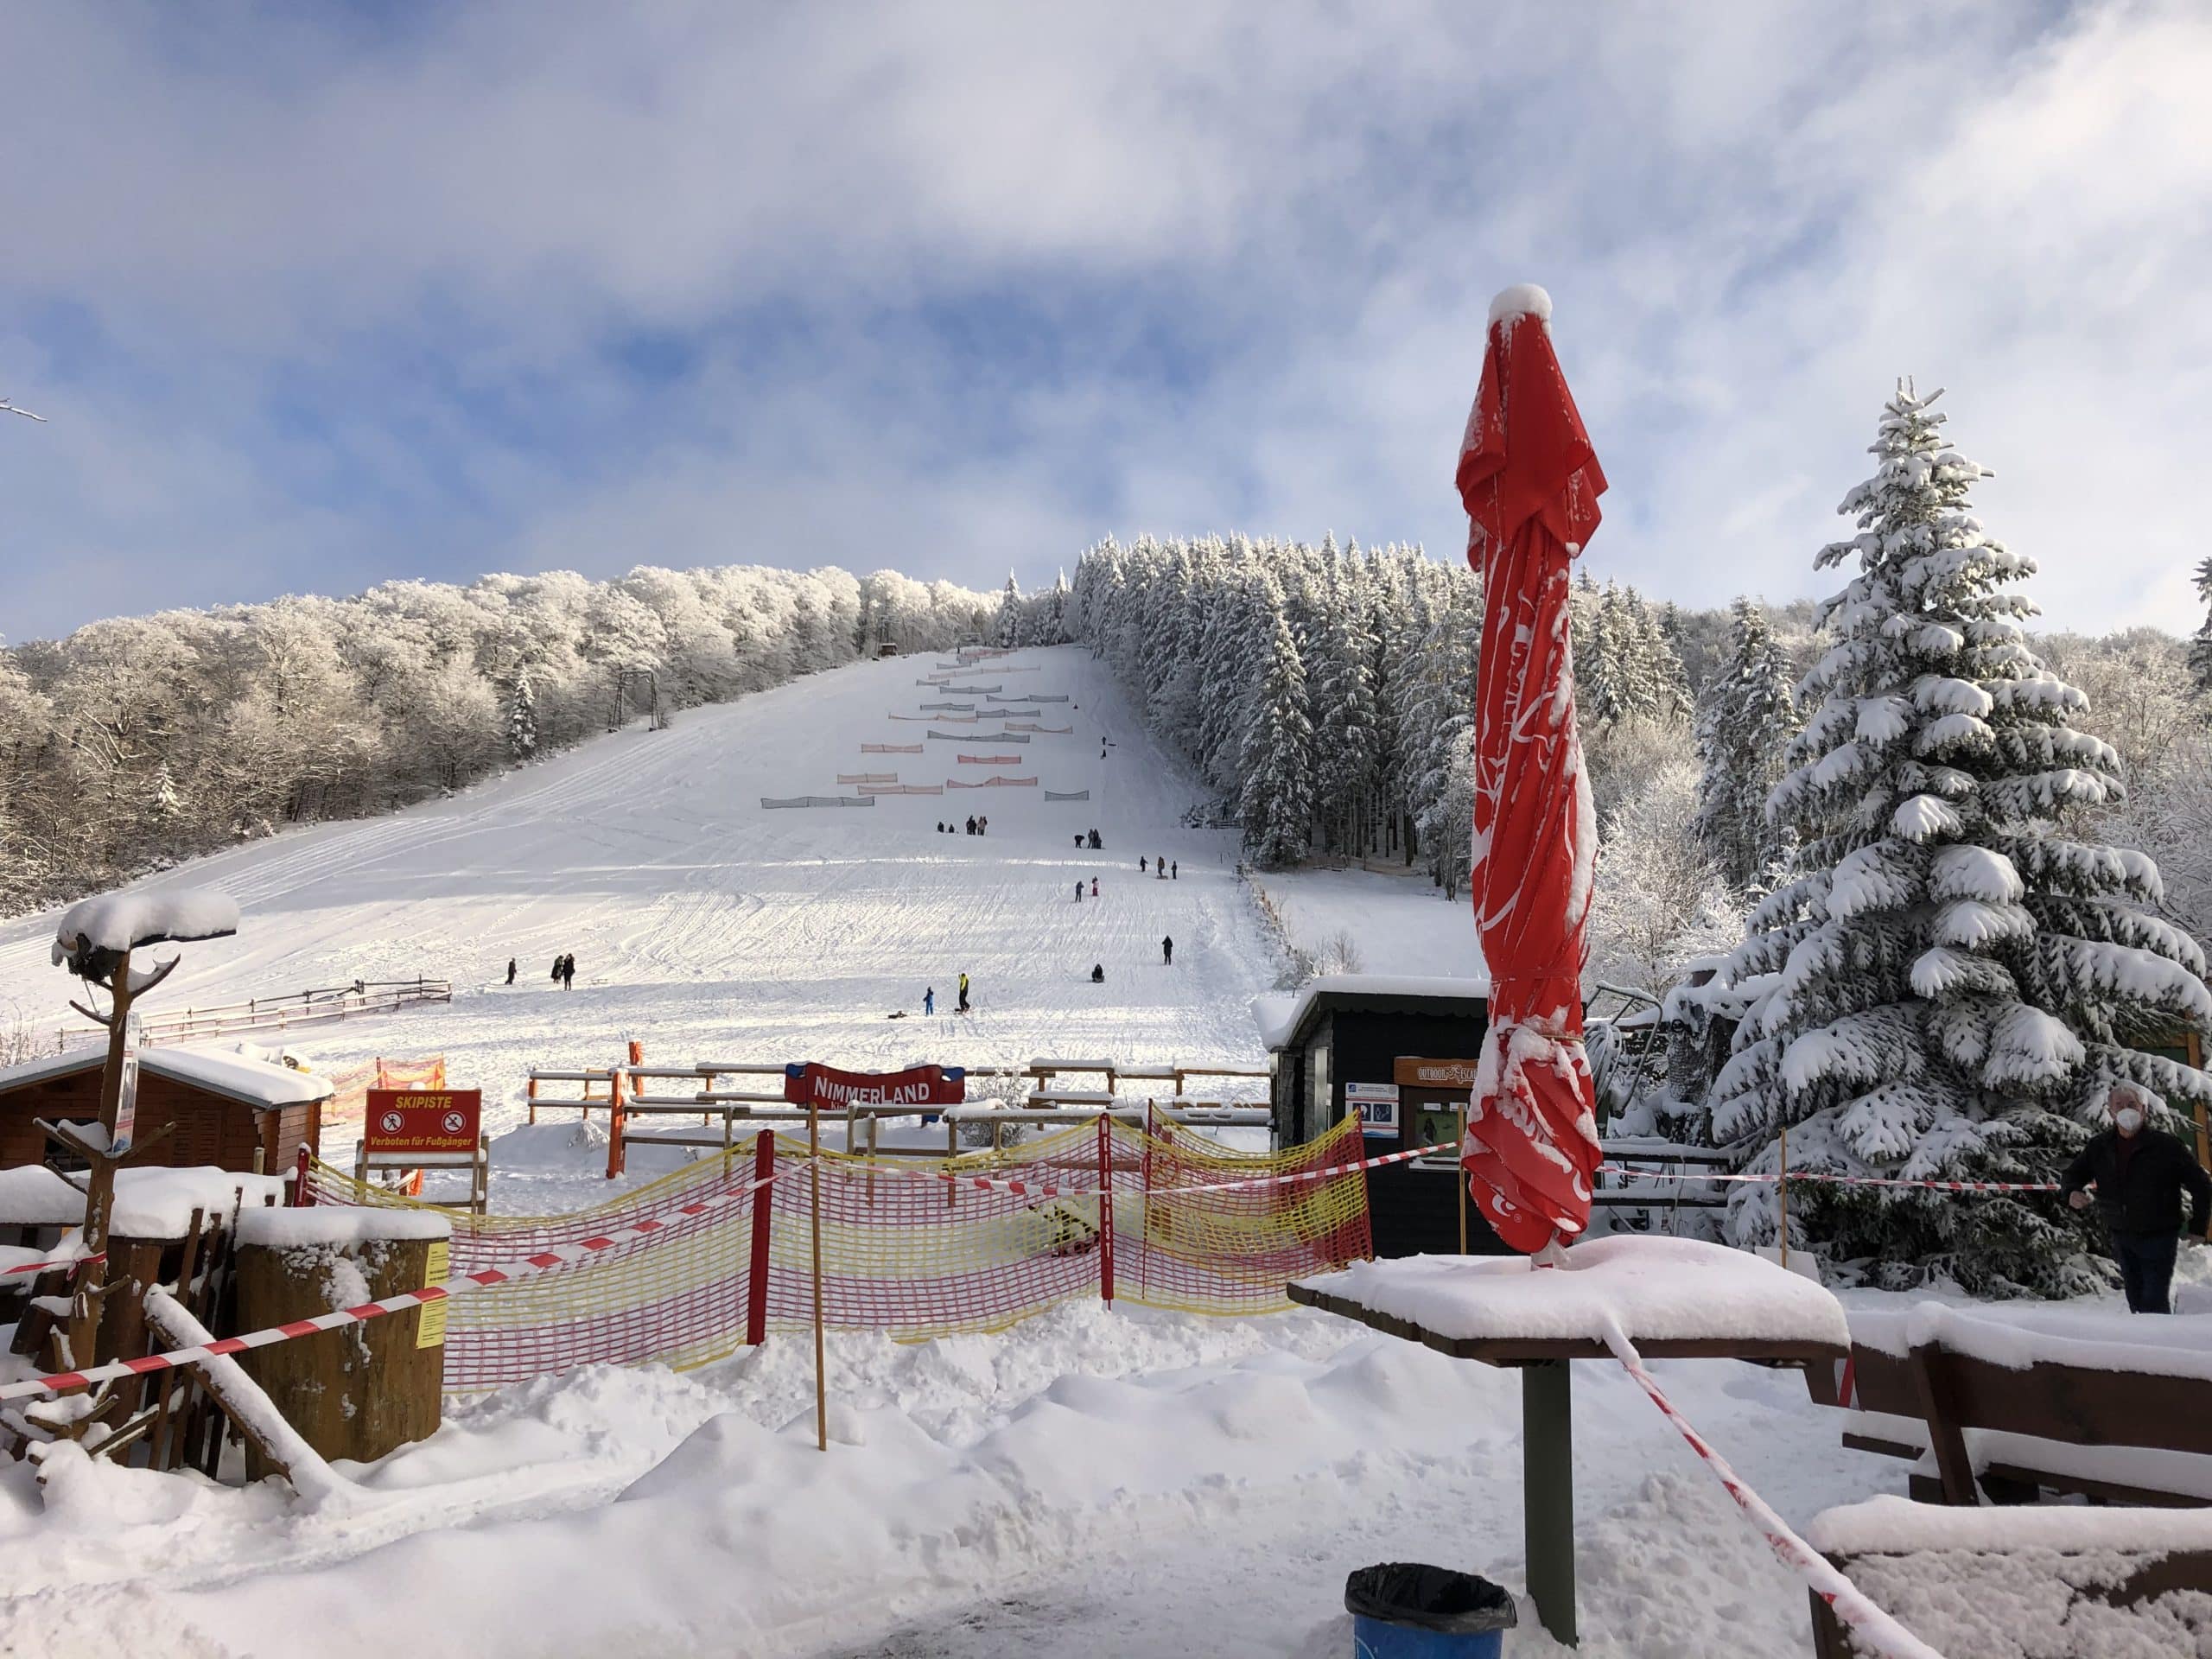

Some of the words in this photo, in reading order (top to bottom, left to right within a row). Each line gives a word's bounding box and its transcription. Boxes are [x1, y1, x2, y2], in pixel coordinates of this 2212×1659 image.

[1418, 1067, 1446, 1080] OUTDOOR
[395, 1096, 453, 1109] SKIPISTE
[371, 1136, 410, 1146] Verboten
[411, 1136, 425, 1146] für
[425, 1136, 473, 1147] Fußgänger
